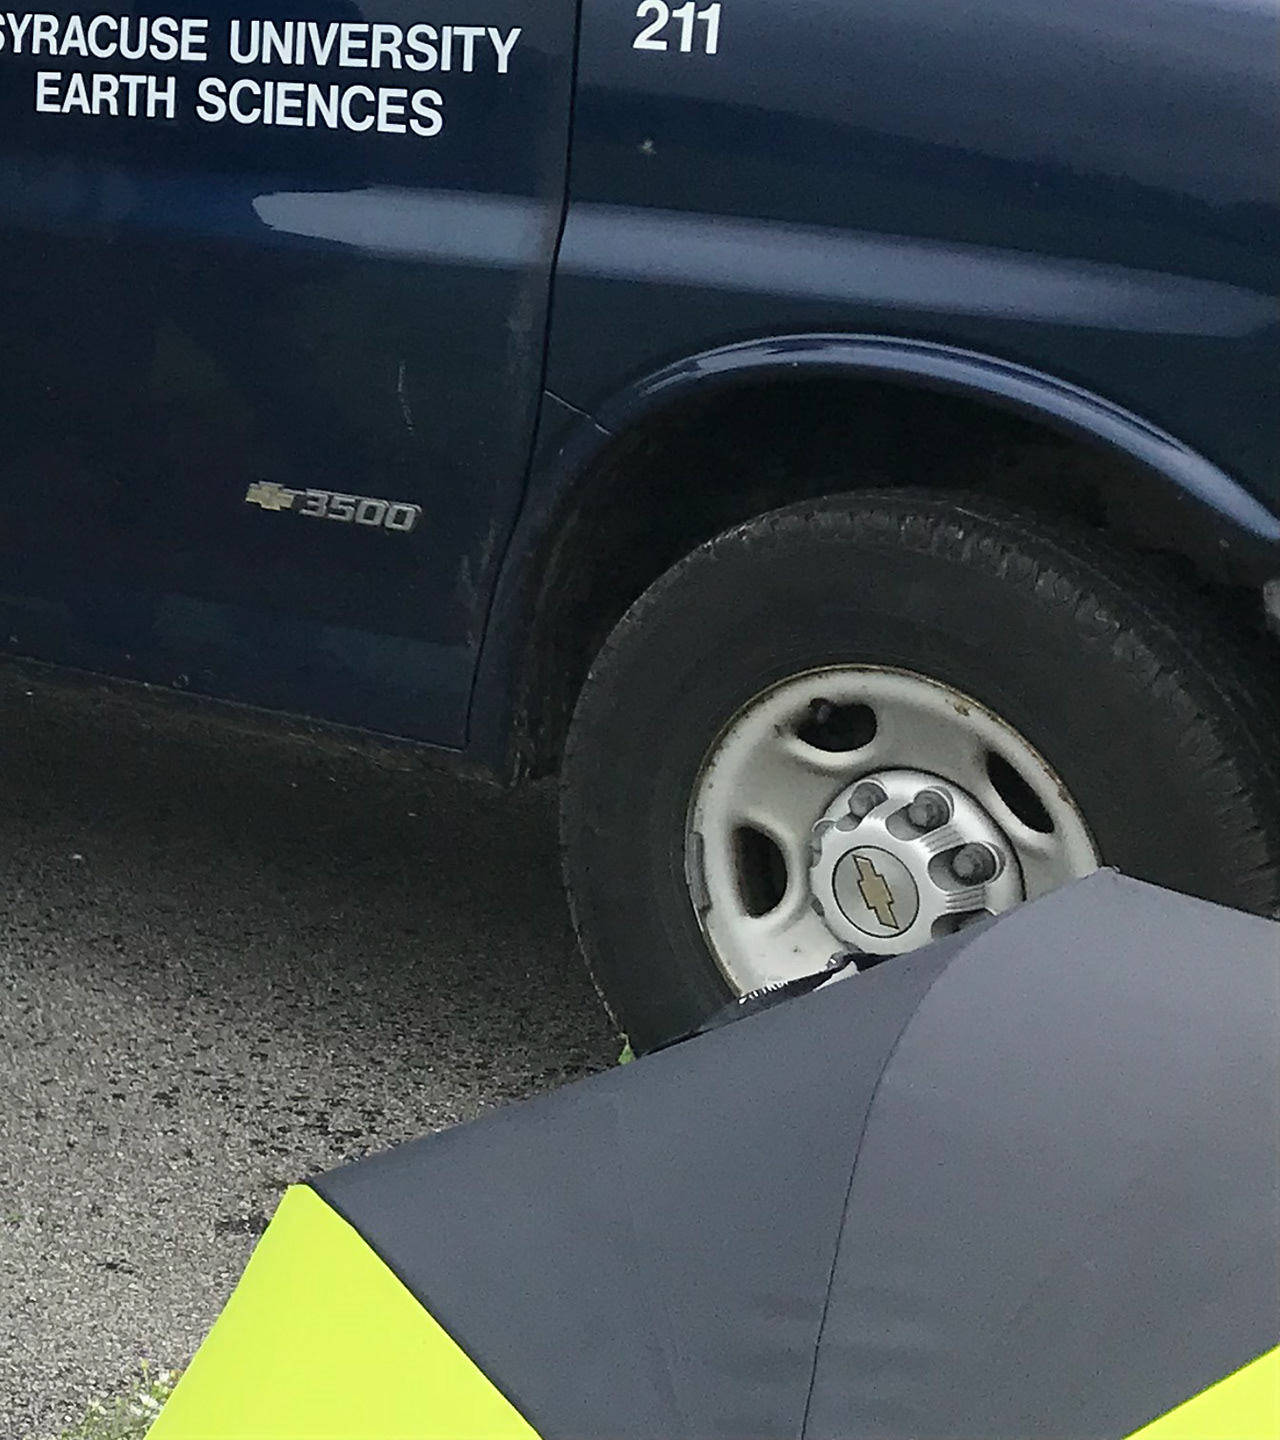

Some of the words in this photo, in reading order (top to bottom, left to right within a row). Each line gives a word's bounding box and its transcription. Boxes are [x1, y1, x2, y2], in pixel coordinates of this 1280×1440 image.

[230, 19, 522, 74] UNIVERSITY
[36, 71, 176, 119] EARTH
[196, 77, 443, 137] SCIENCES
[299, 489, 422, 532] 3500
